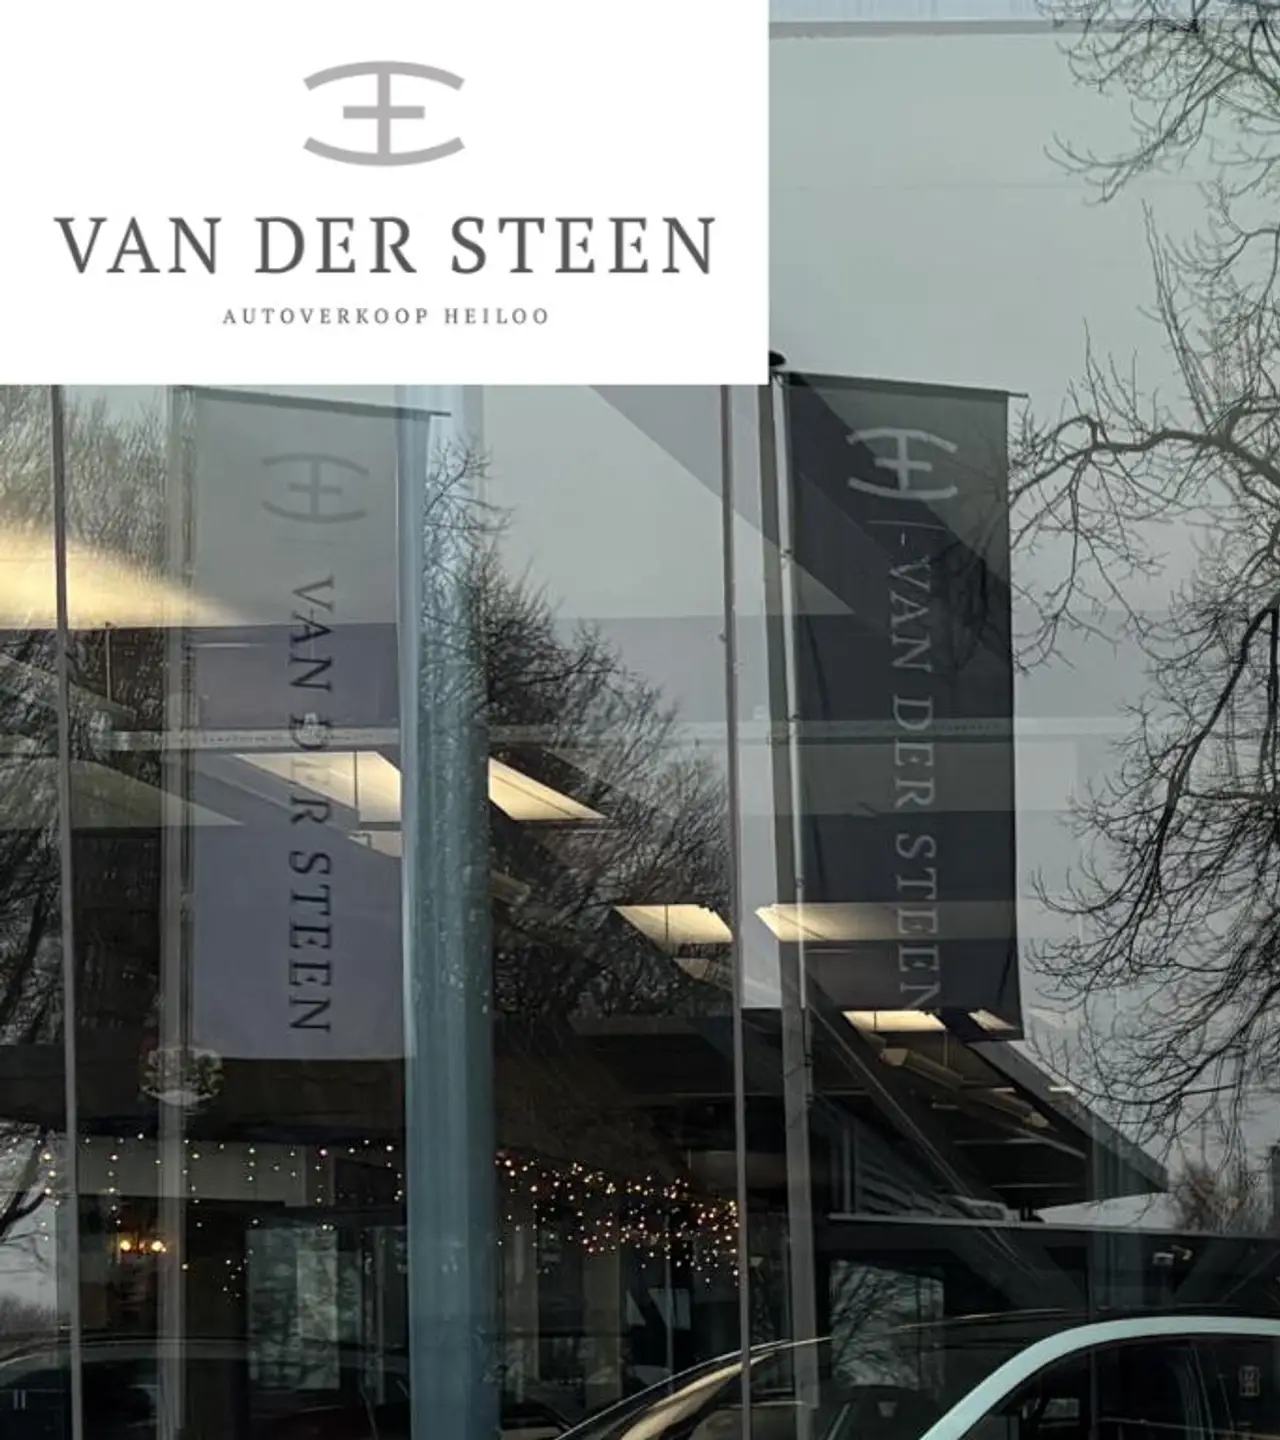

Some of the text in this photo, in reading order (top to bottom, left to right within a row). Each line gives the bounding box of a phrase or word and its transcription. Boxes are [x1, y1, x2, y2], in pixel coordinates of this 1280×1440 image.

[289, 575, 334, 694] VAN
[889, 555, 941, 1016] VAN DER STEEN
[288, 849, 332, 1034] STEEN
